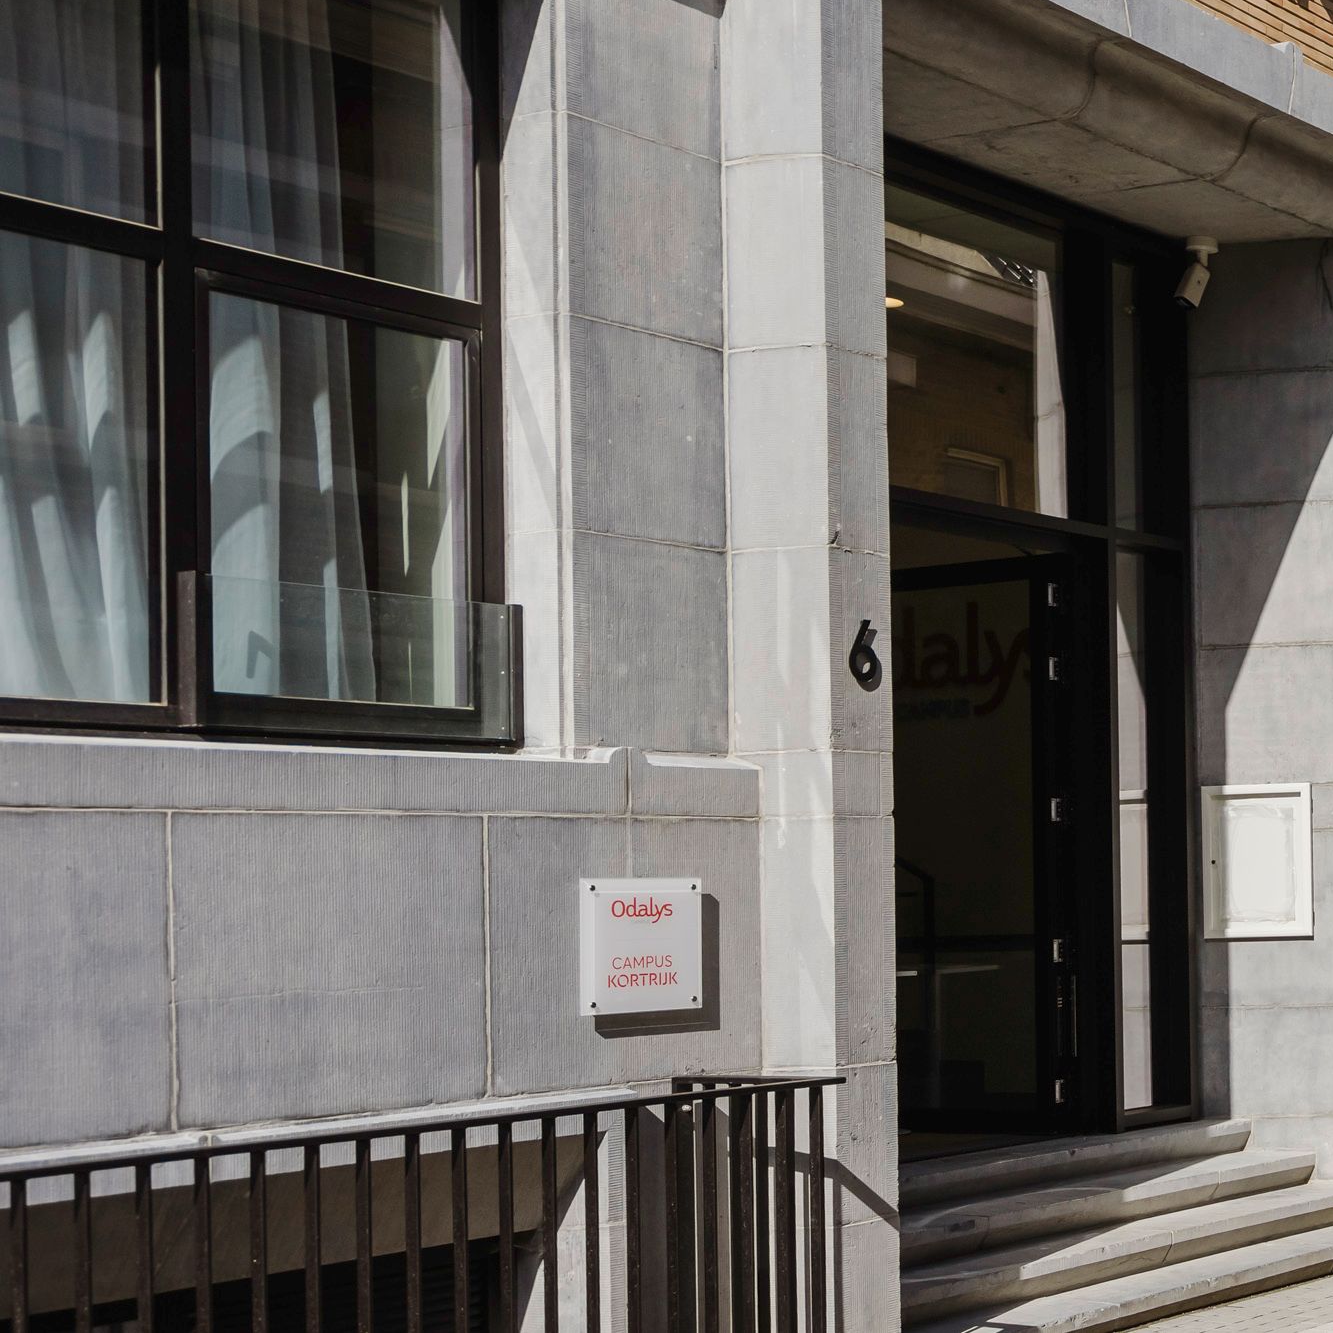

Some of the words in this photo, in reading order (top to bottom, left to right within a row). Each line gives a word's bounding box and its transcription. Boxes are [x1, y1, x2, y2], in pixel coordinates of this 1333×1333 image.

[848, 619, 878, 684] 6
[611, 896, 673, 924] Odalys
[612, 954, 673, 970] CAMPUS
[607, 971, 678, 988] KORTRIJK
